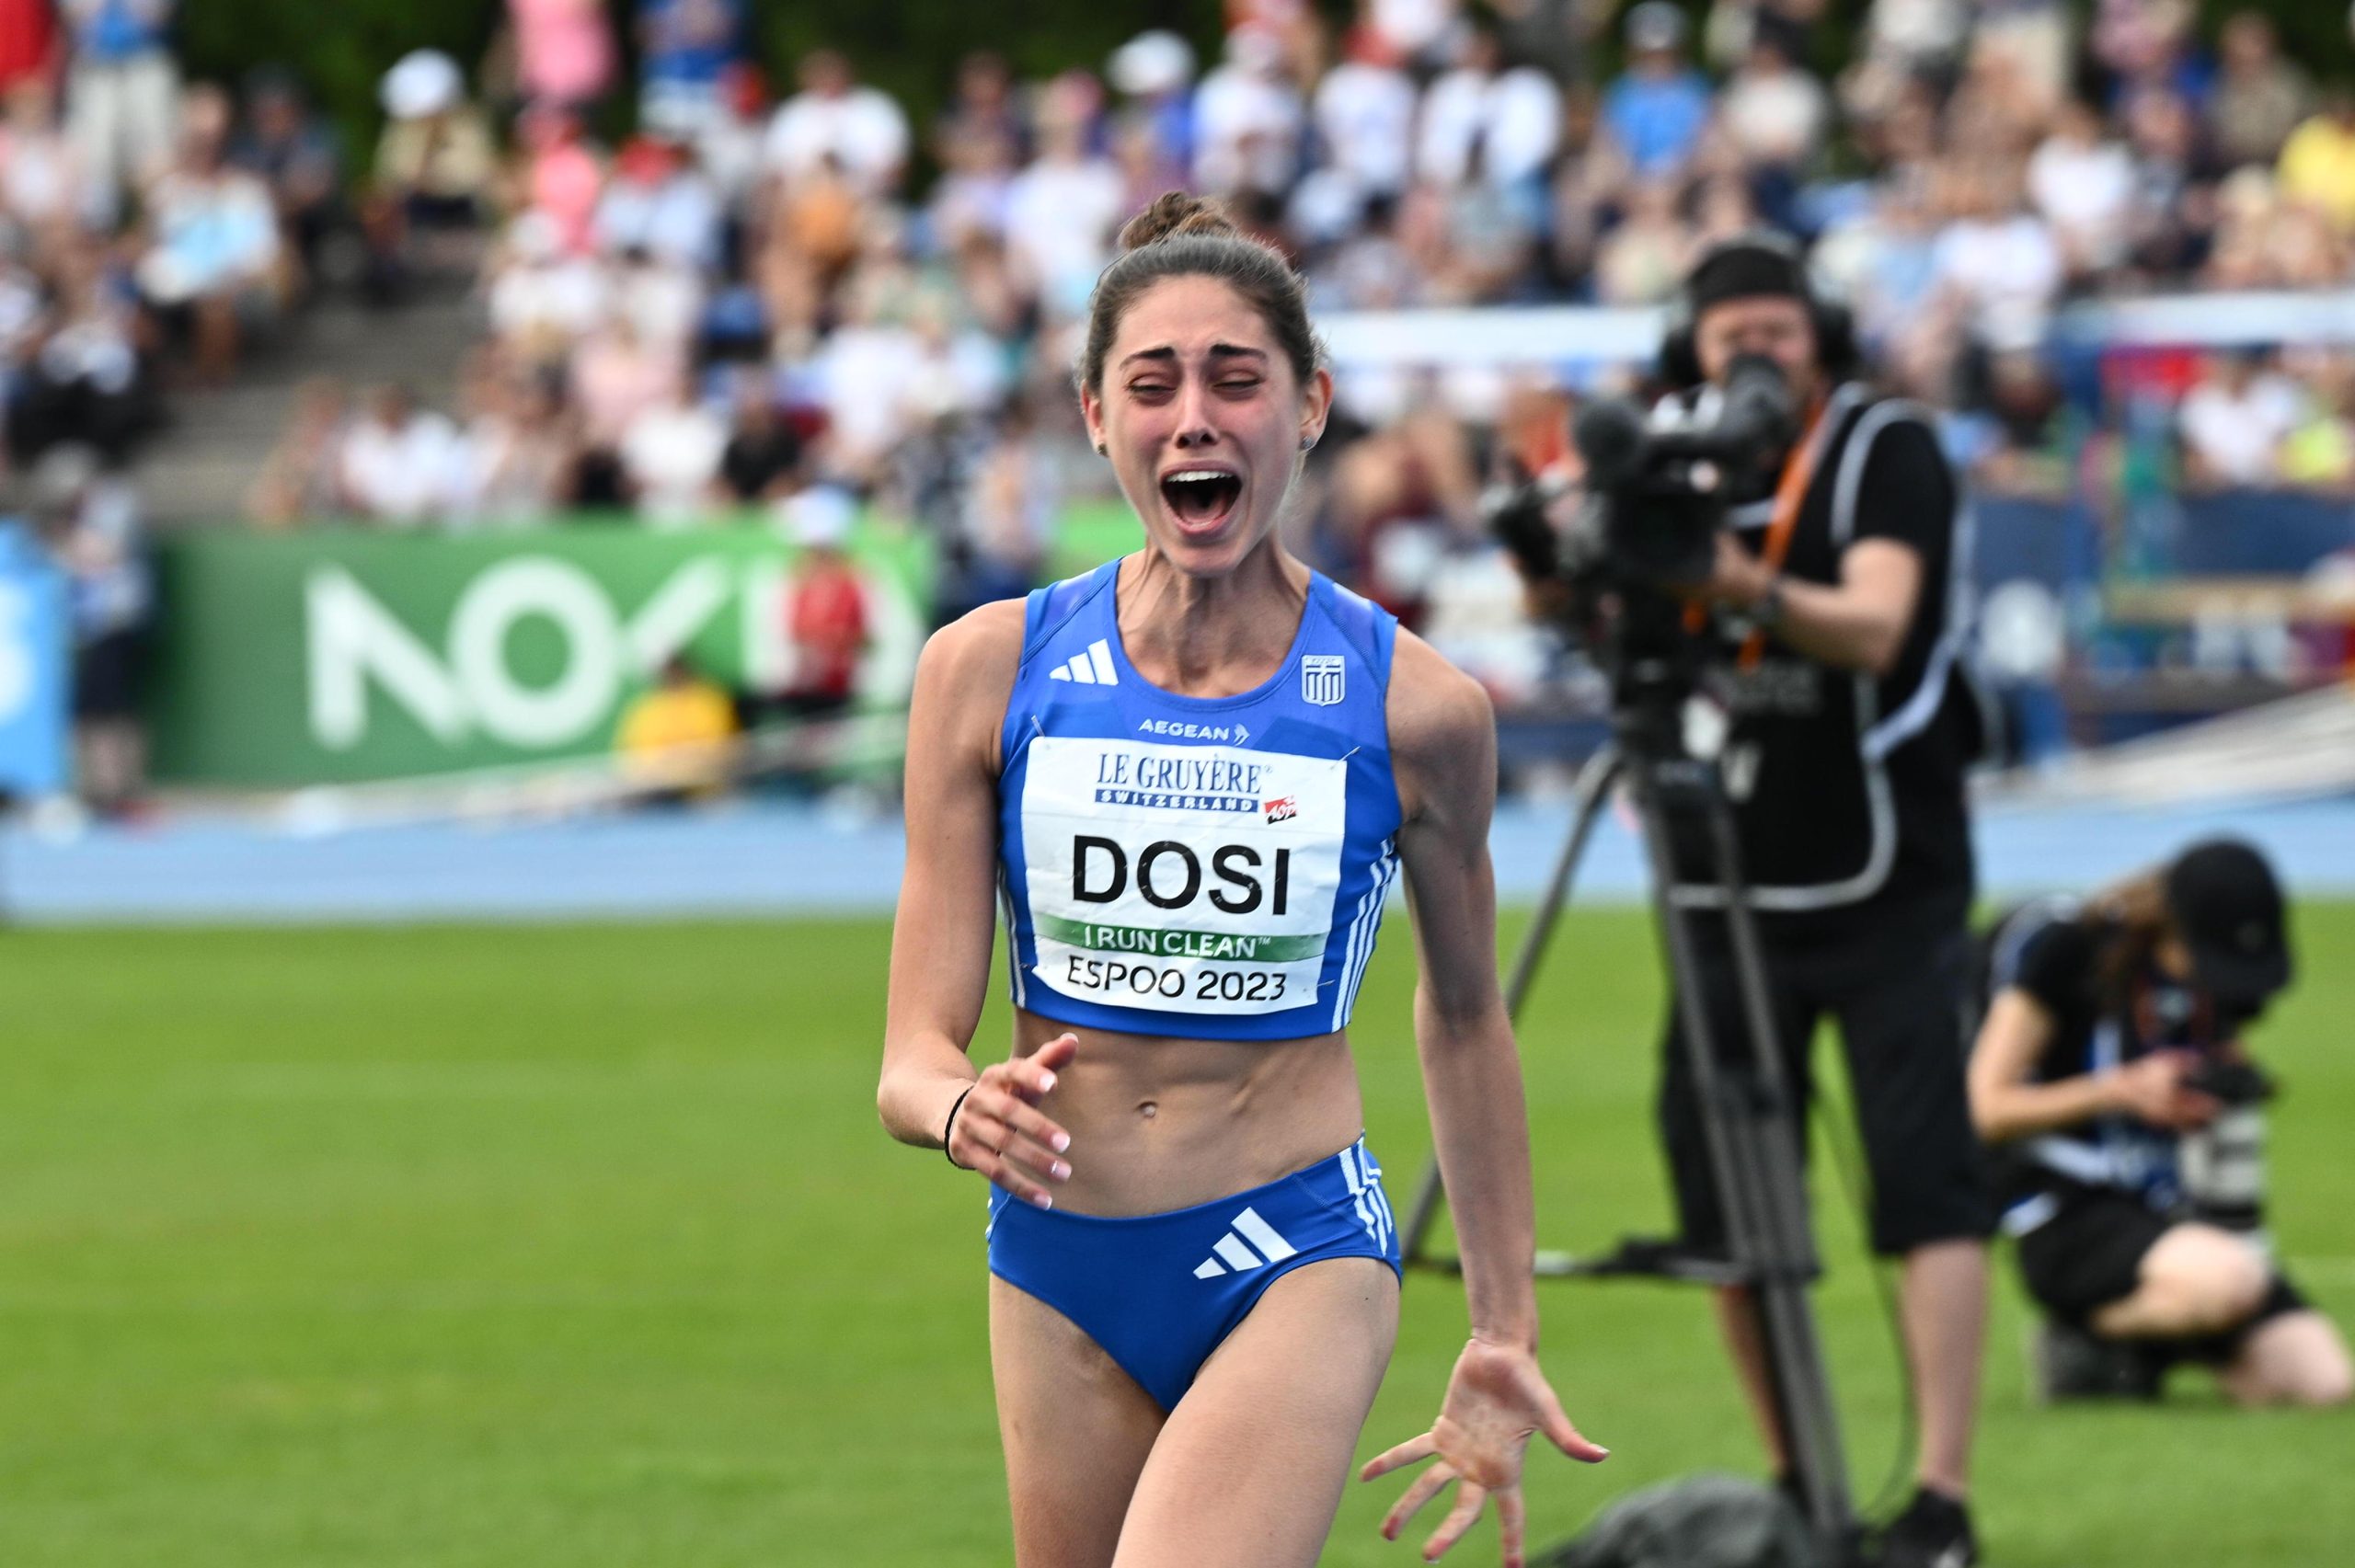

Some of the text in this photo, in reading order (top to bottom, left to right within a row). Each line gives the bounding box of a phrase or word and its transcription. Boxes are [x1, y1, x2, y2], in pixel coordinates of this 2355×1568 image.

[1137, 718, 1231, 742] AEGEAN
[1097, 752, 1131, 784] LE
[1101, 791, 1252, 812] SWITZERLAND
[1072, 834, 1291, 916] DOSI
[1084, 924, 1092, 947] I
[1097, 926, 1158, 954] RUN
[1067, 953, 1288, 1001] ESPOO 2023
